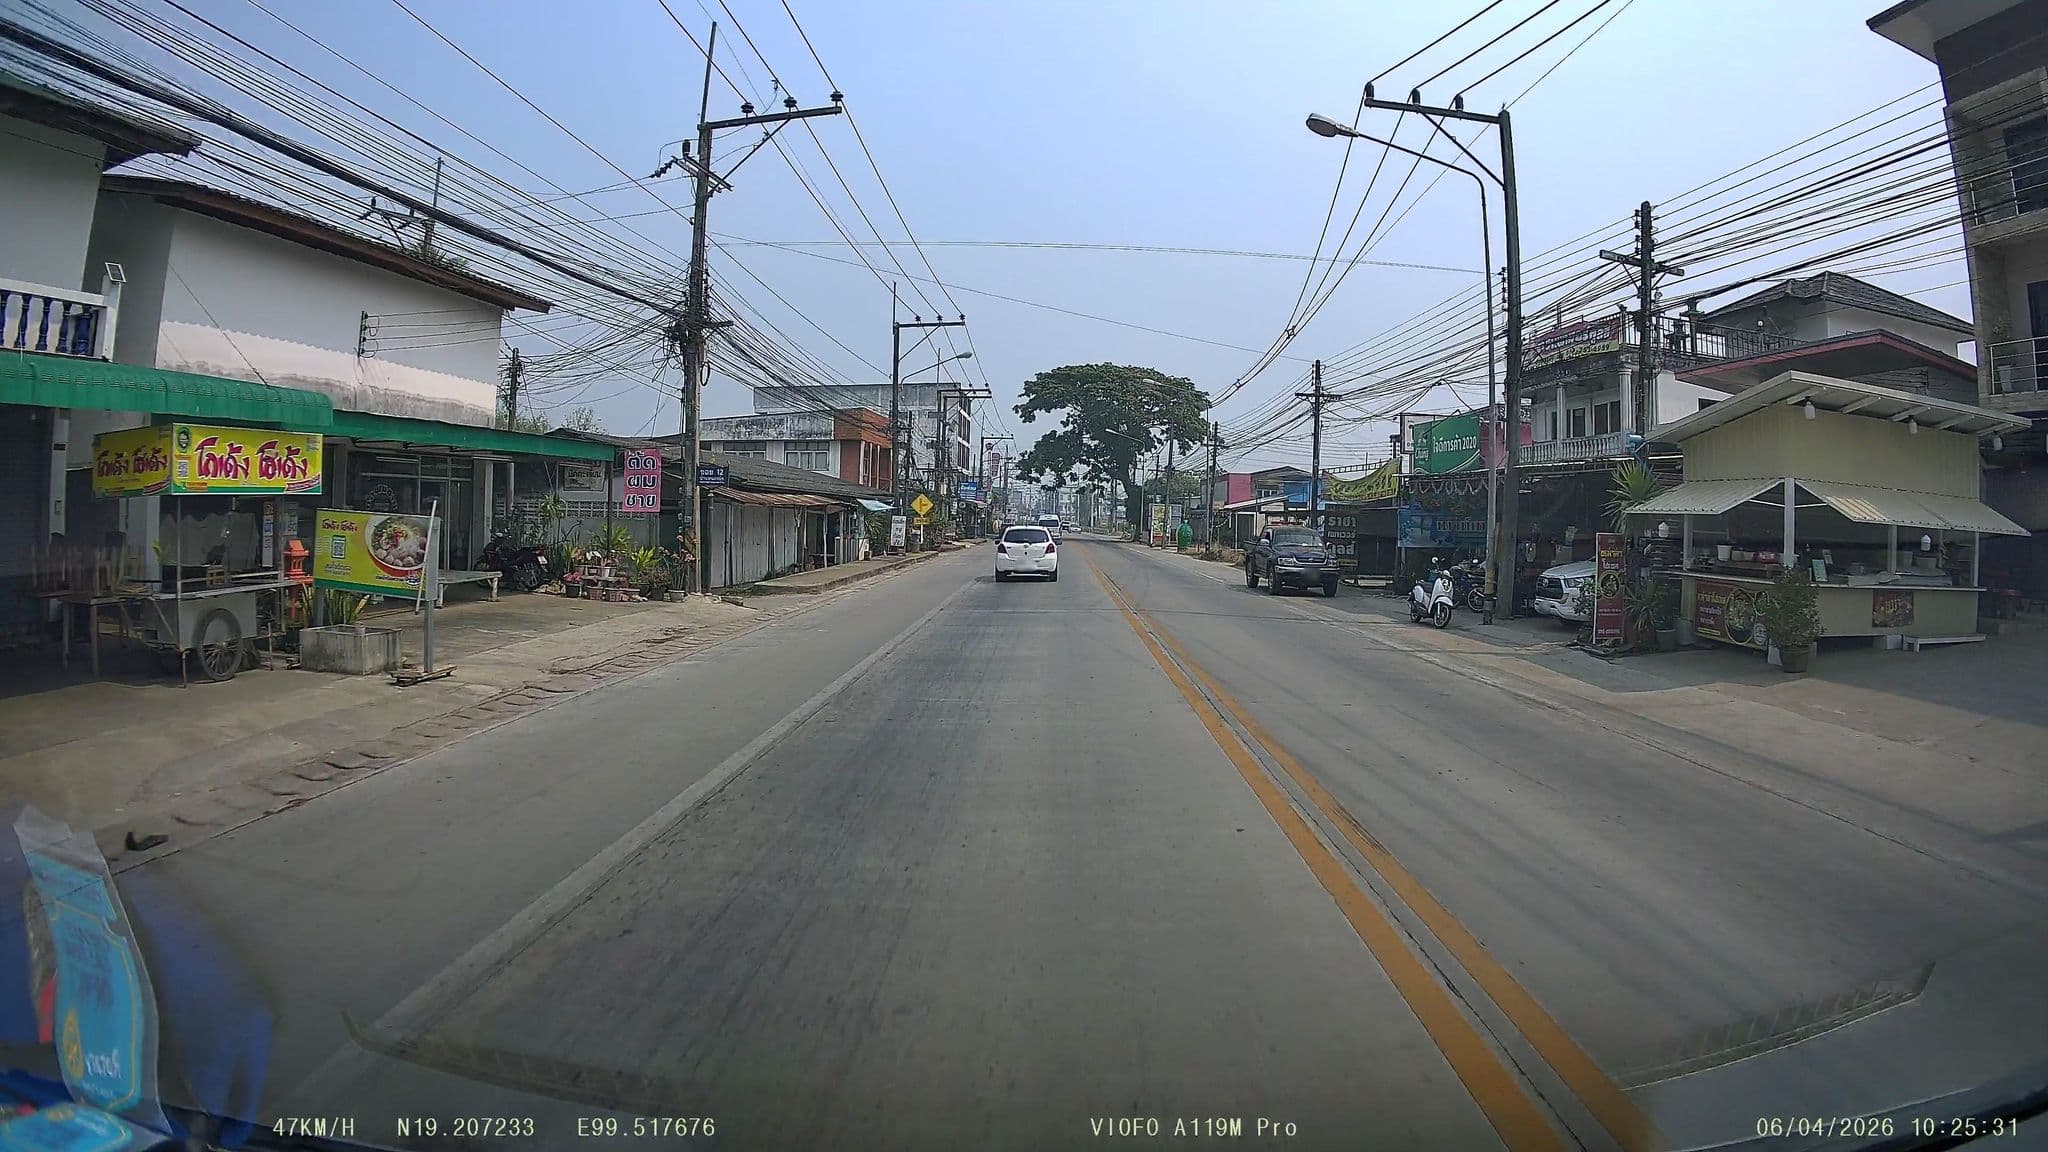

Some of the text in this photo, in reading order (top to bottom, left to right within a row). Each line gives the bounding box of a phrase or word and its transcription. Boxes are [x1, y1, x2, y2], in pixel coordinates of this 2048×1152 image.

[1463, 436, 1477, 450] 2020
[626, 451, 657, 470] ตัด
[717, 468, 724, 476] 12
[626, 475, 657, 489] ผม
[625, 494, 657, 508] ชาย
[1328, 516, 1356, 527] ราชา
[1328, 530, 1356, 539] เพาเวอร์
